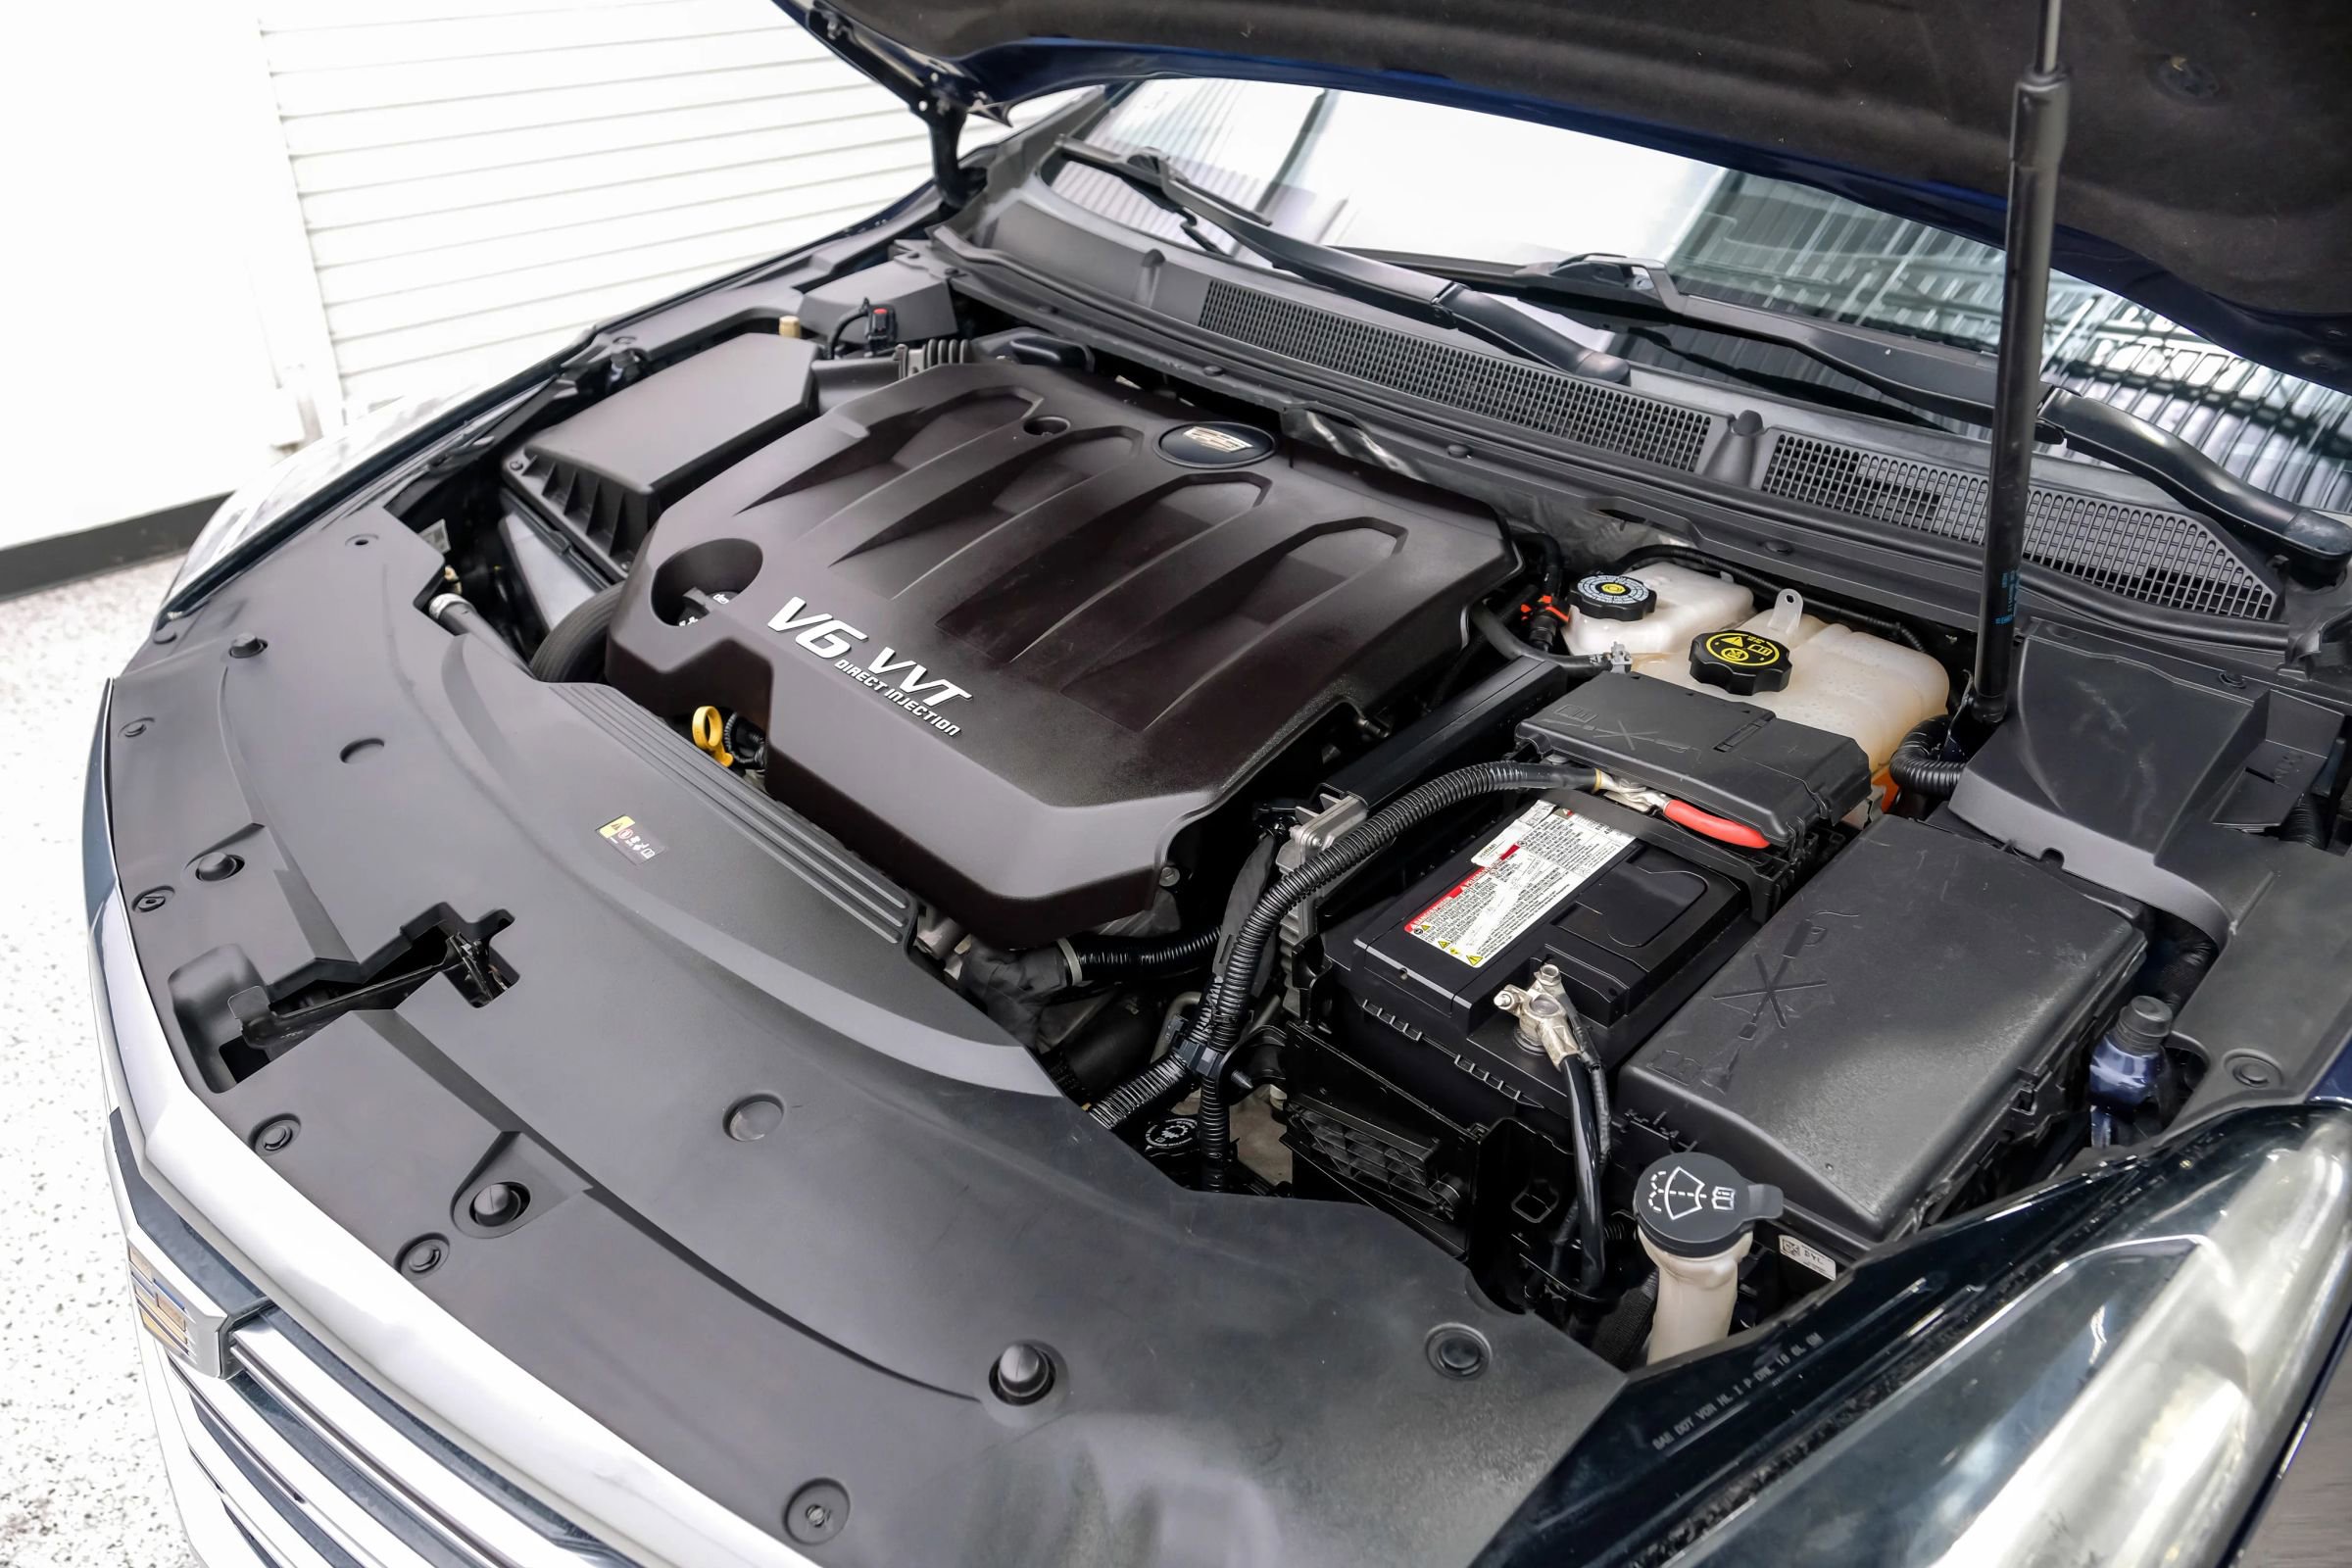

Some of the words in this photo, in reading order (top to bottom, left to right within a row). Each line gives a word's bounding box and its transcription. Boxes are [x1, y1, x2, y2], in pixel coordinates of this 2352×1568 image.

[767, 596, 869, 659] V6
[867, 647, 973, 707] VVT
[834, 659, 888, 692] DIRECT
[884, 688, 962, 736] INJECTION
